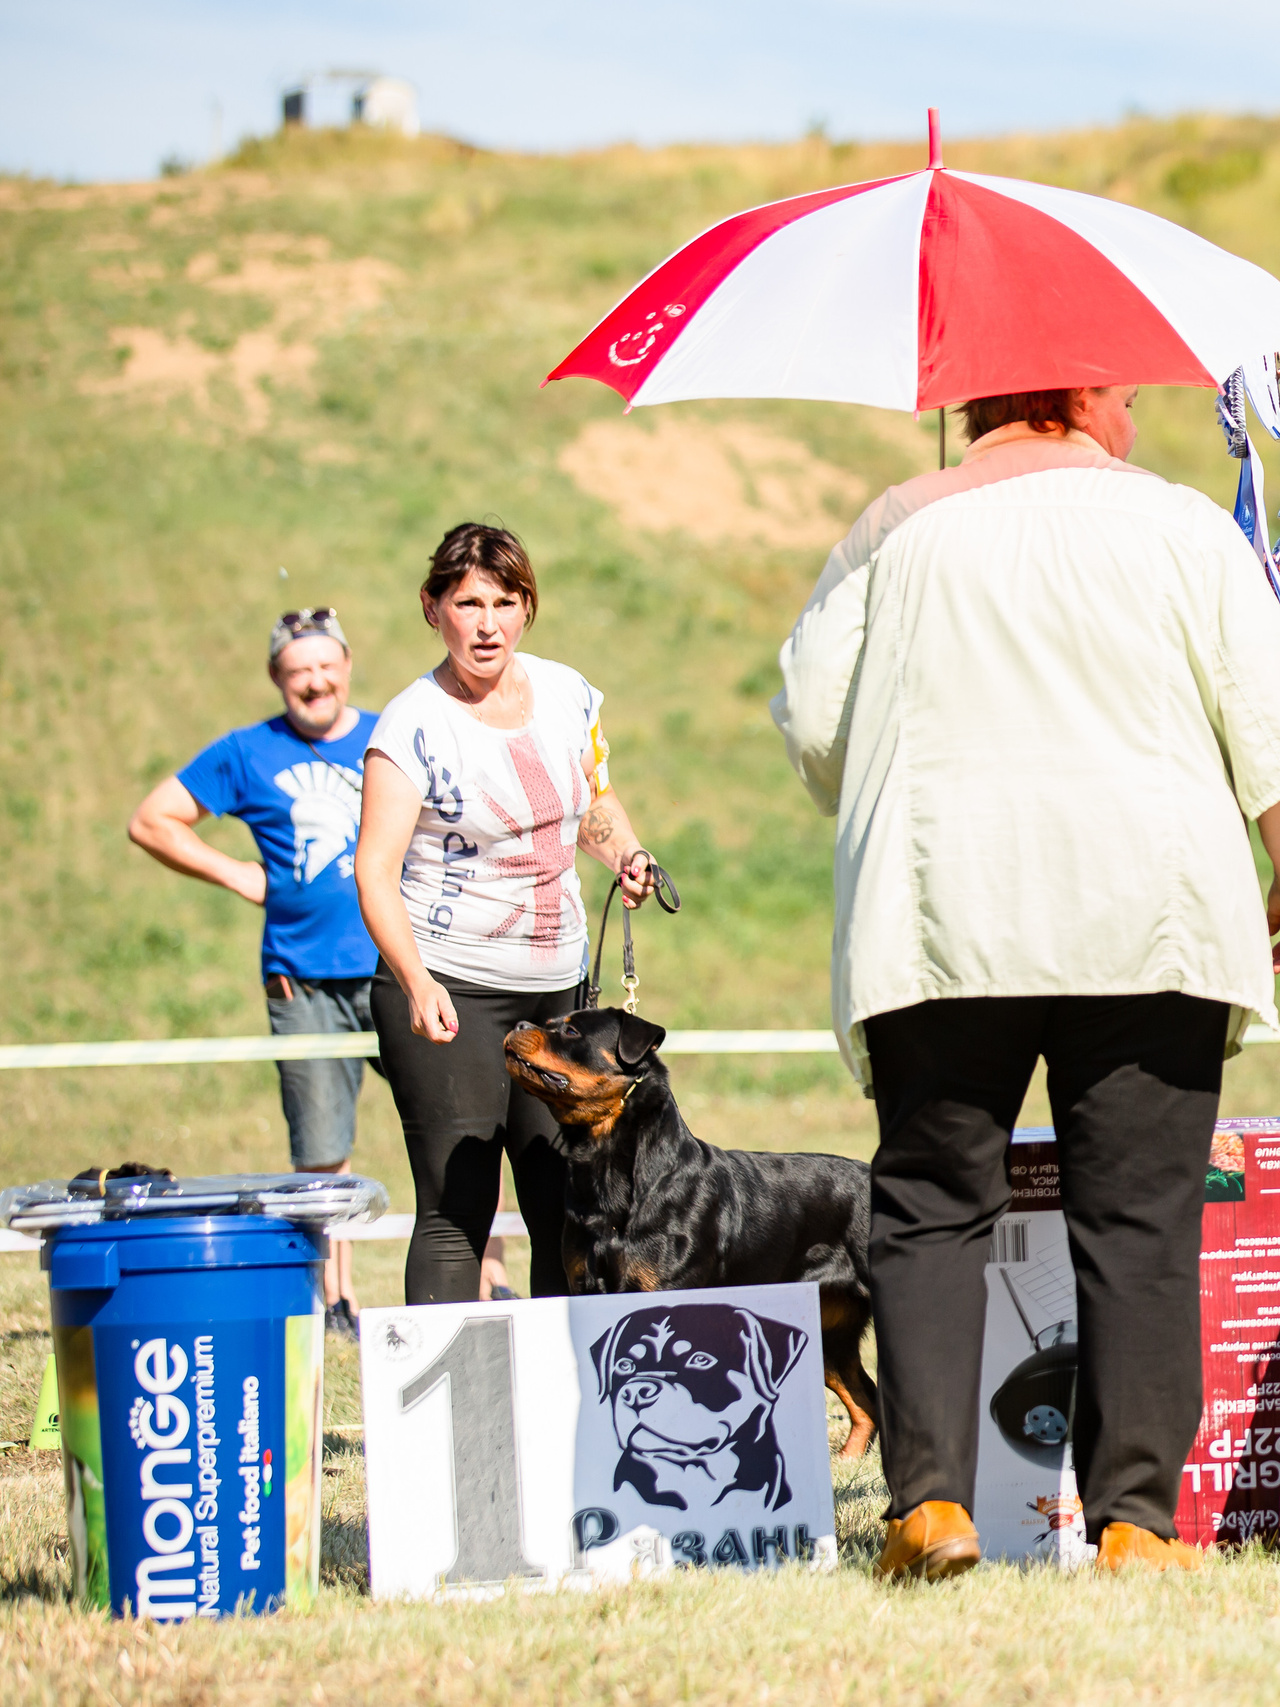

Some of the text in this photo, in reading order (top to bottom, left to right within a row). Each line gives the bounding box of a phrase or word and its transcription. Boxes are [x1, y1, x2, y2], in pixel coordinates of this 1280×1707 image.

[1010, 1165, 1027, 1174] ОВ
[1029, 1165, 1037, 1173] И
[1253, 1249, 1266, 1258] из
[1210, 1340, 1250, 1352] корпуса
[400, 1314, 547, 1589] 1
[191, 1335, 222, 1618] Natural Superpremium
[237, 1375, 261, 1570] Pet food italiano
